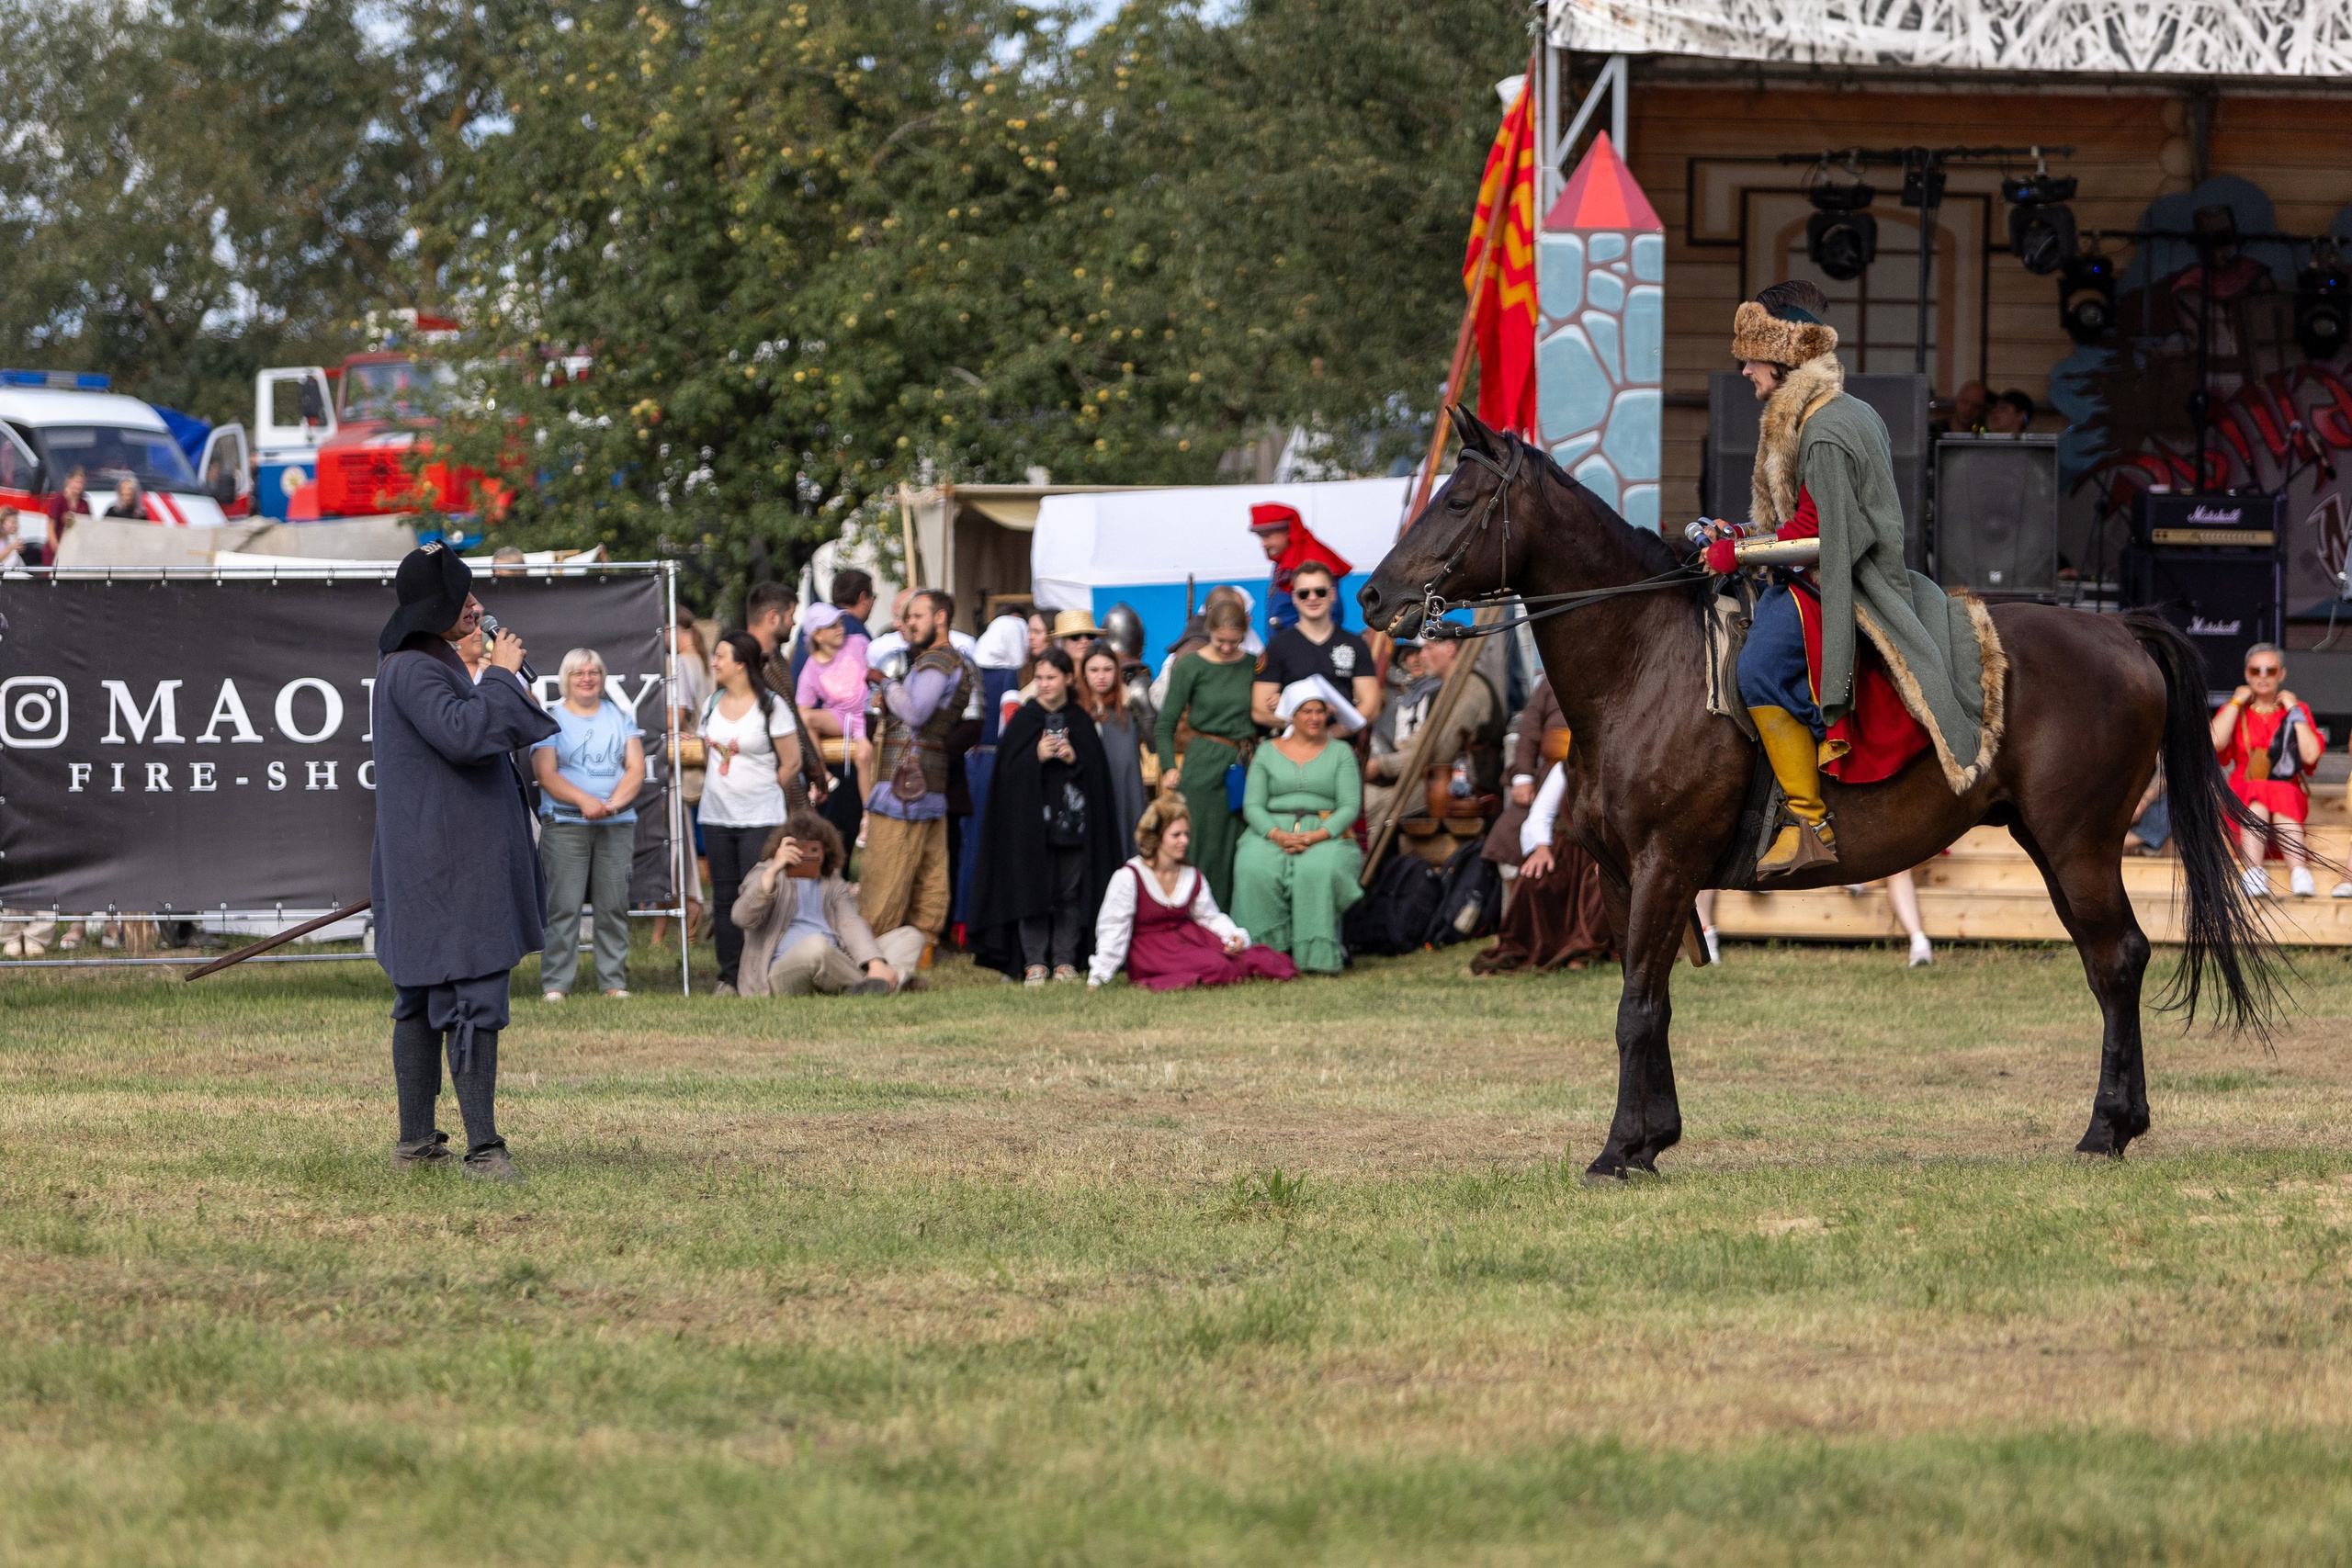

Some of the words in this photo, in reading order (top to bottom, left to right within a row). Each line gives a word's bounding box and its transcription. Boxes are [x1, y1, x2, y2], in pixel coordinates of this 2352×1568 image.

[2187, 504, 2242, 525] Marshall
[2186, 615, 2241, 636] Marshall
[68, 760, 378, 792] FIRE-SHO
